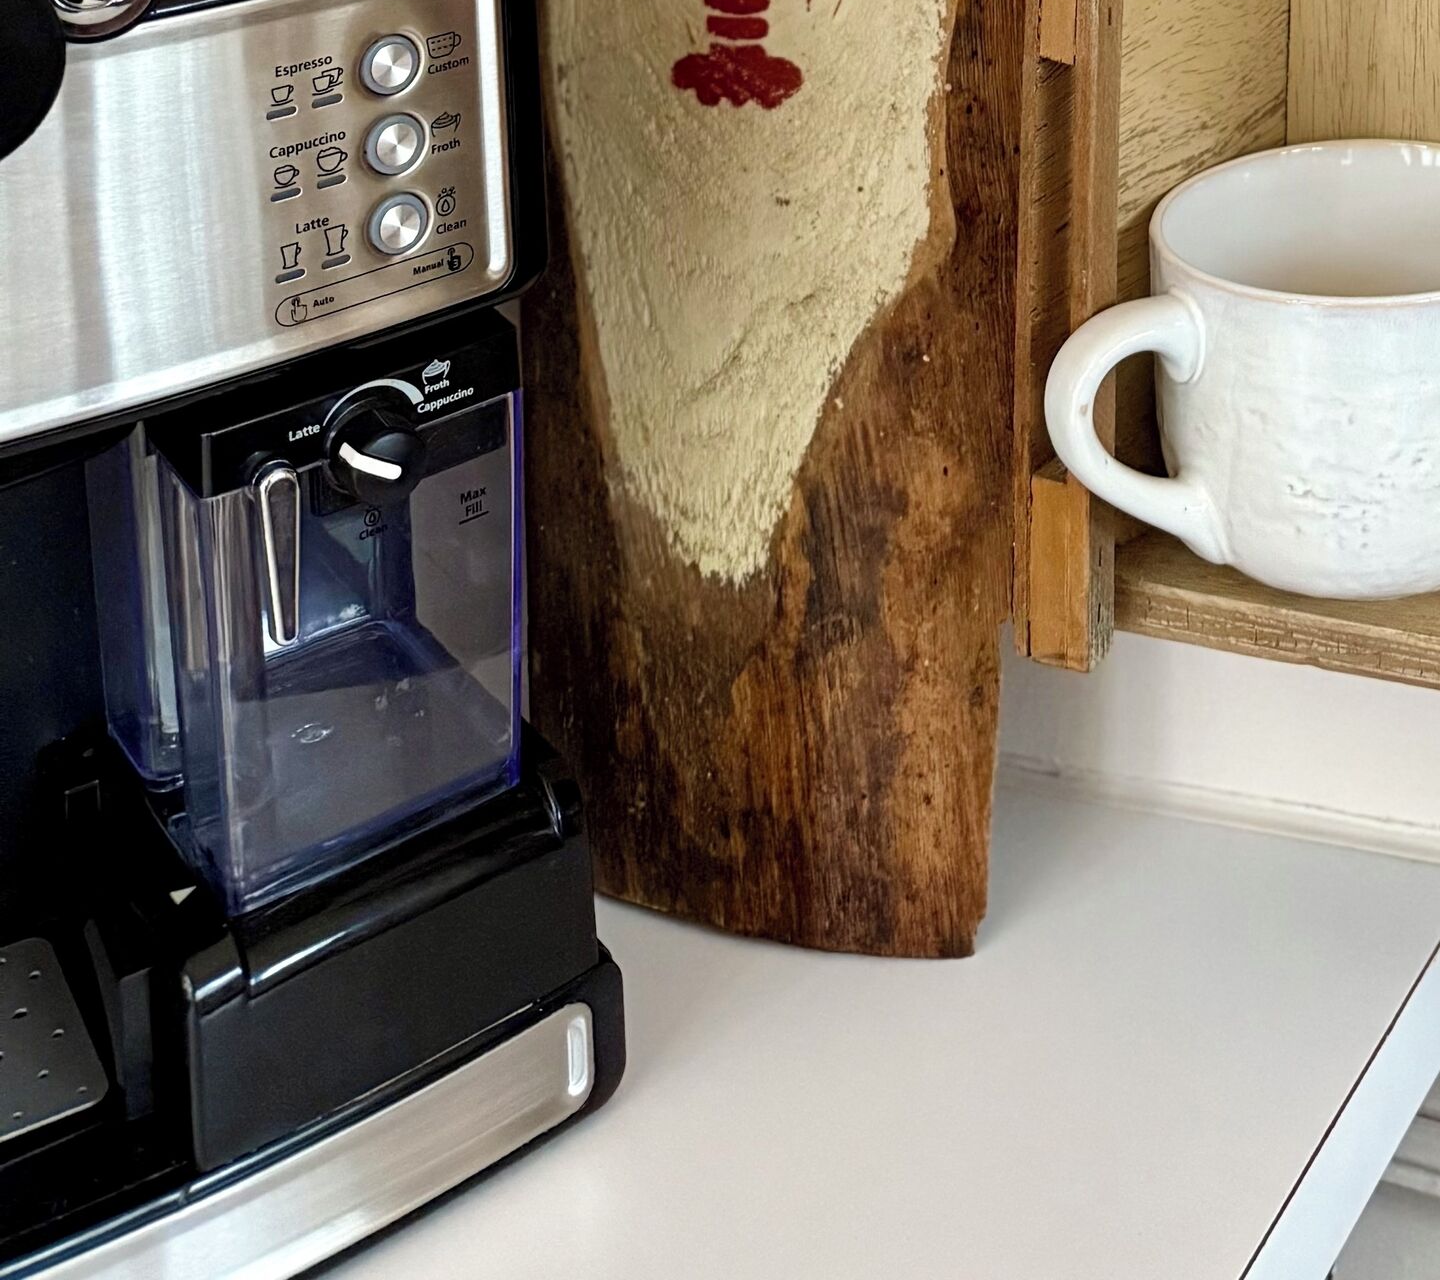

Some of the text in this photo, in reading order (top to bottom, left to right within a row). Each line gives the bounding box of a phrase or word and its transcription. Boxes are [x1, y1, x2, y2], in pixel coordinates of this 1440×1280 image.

[275, 55, 333, 78] Espresso
[427, 55, 470, 75] Custom
[269, 130, 346, 159] Cappuccino
[431, 138, 461, 155] Froth
[295, 216, 330, 234] Latte
[436, 218, 467, 235] Clean
[413, 259, 445, 276] Manual
[312, 295, 335, 308] Auto
[424, 378, 450, 395] Froth
[416, 386, 474, 414] Cappuccino
[288, 423, 321, 442] Latte
[459, 486, 487, 504] Max
[465, 500, 483, 518] Fill
[359, 522, 388, 540] Clean
